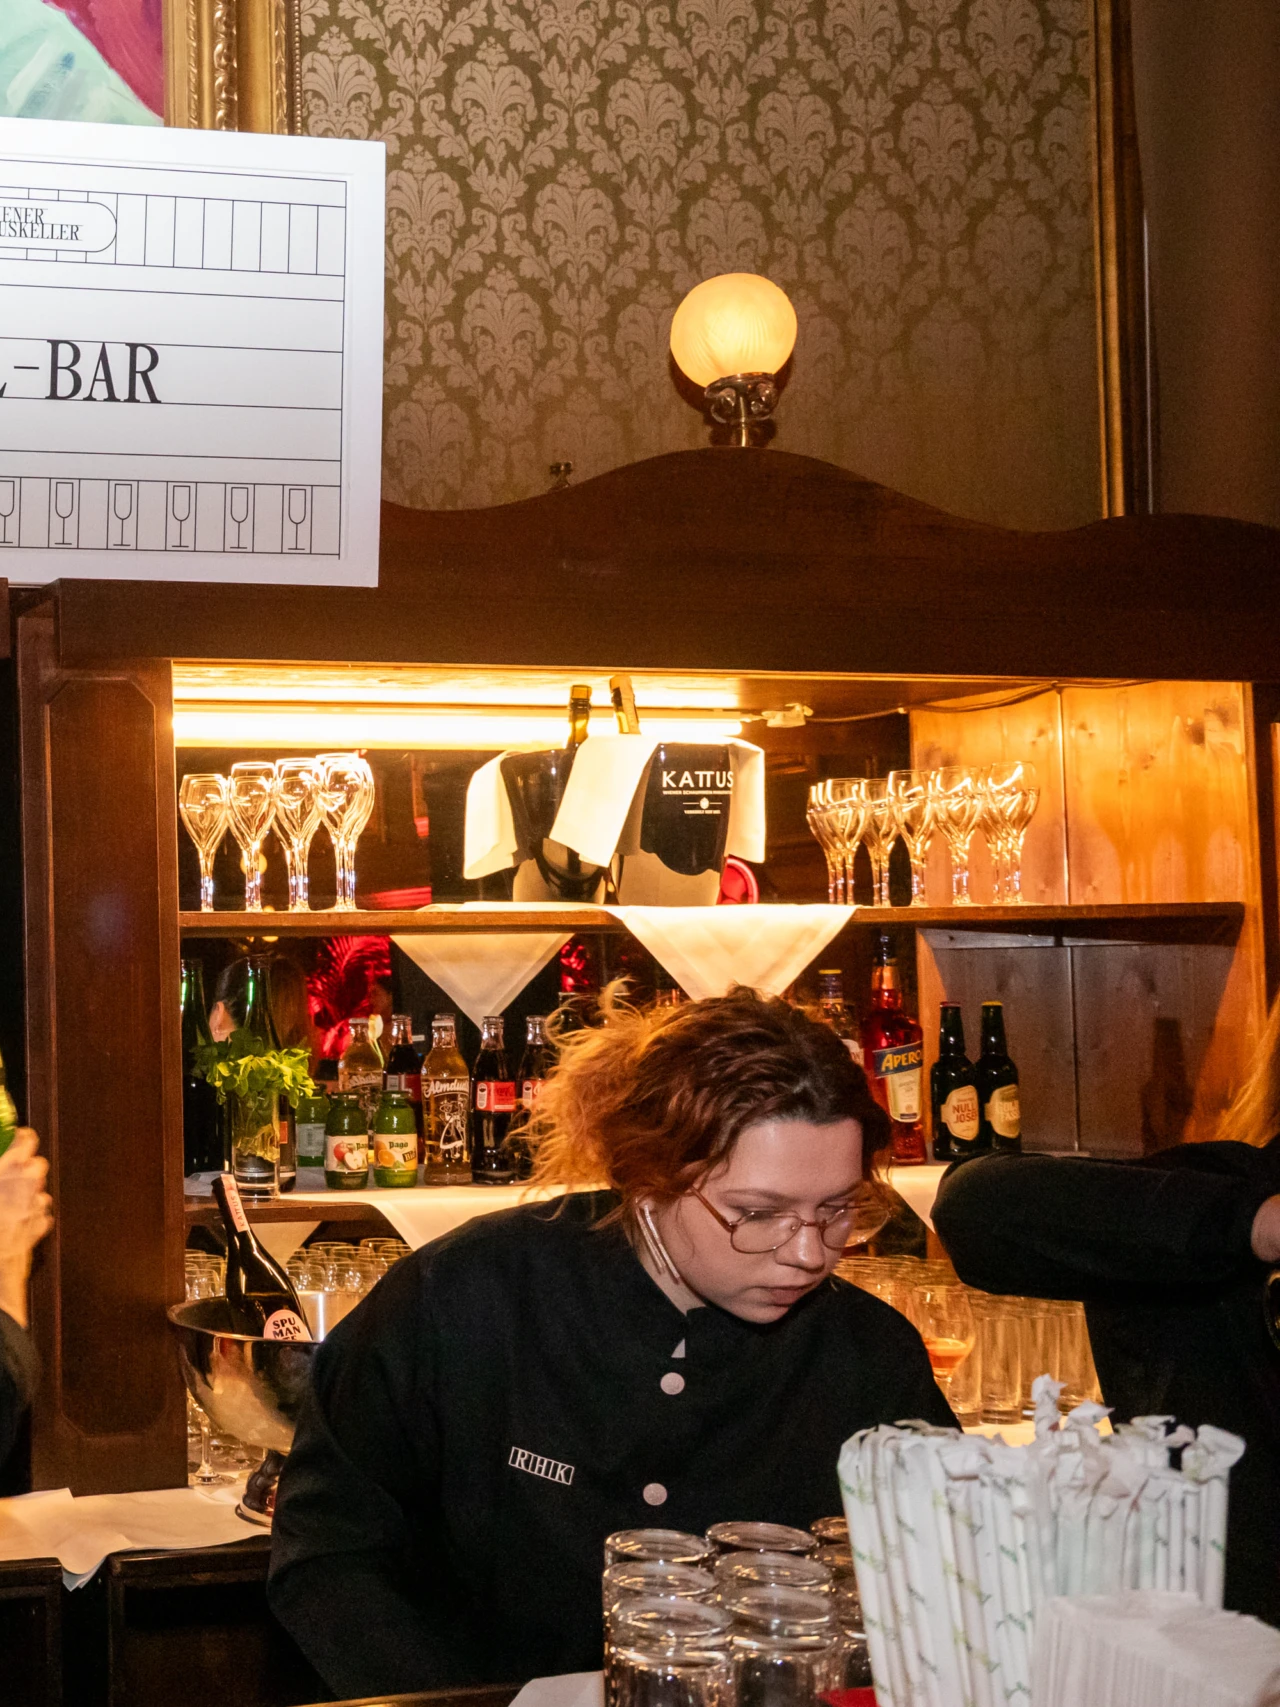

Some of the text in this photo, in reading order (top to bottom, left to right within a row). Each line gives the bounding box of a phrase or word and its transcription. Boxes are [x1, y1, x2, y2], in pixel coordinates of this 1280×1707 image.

[662, 771, 734, 788] KATTUS
[881, 1050, 921, 1072] APERO
[424, 1078, 468, 1098] Almdud
[272, 1317, 296, 1329] SPU
[272, 1325, 301, 1339] MAN
